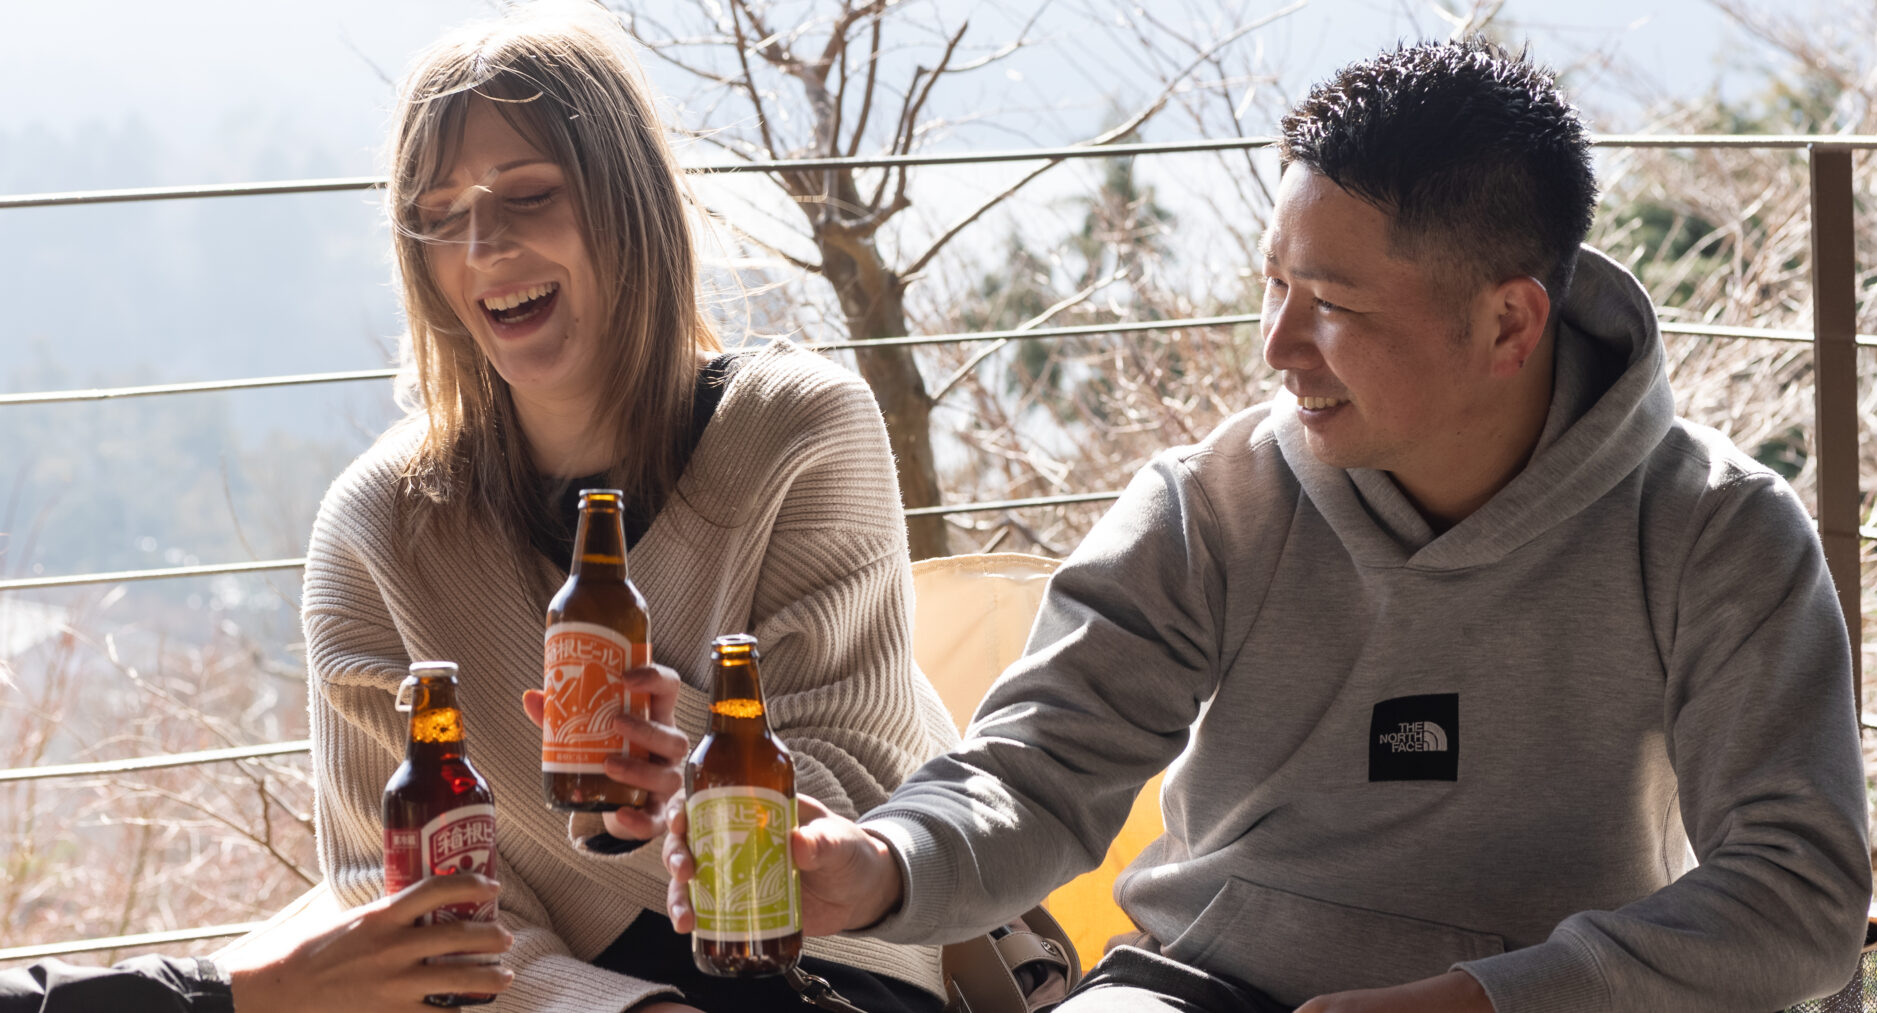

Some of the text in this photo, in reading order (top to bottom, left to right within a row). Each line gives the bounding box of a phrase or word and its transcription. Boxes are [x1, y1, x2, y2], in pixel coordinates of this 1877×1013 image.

[1398, 722, 1424, 733] THE
[1379, 732, 1424, 744] NORTH
[1391, 743, 1424, 753] FACE
[438, 822, 494, 855] 箱根ビ
